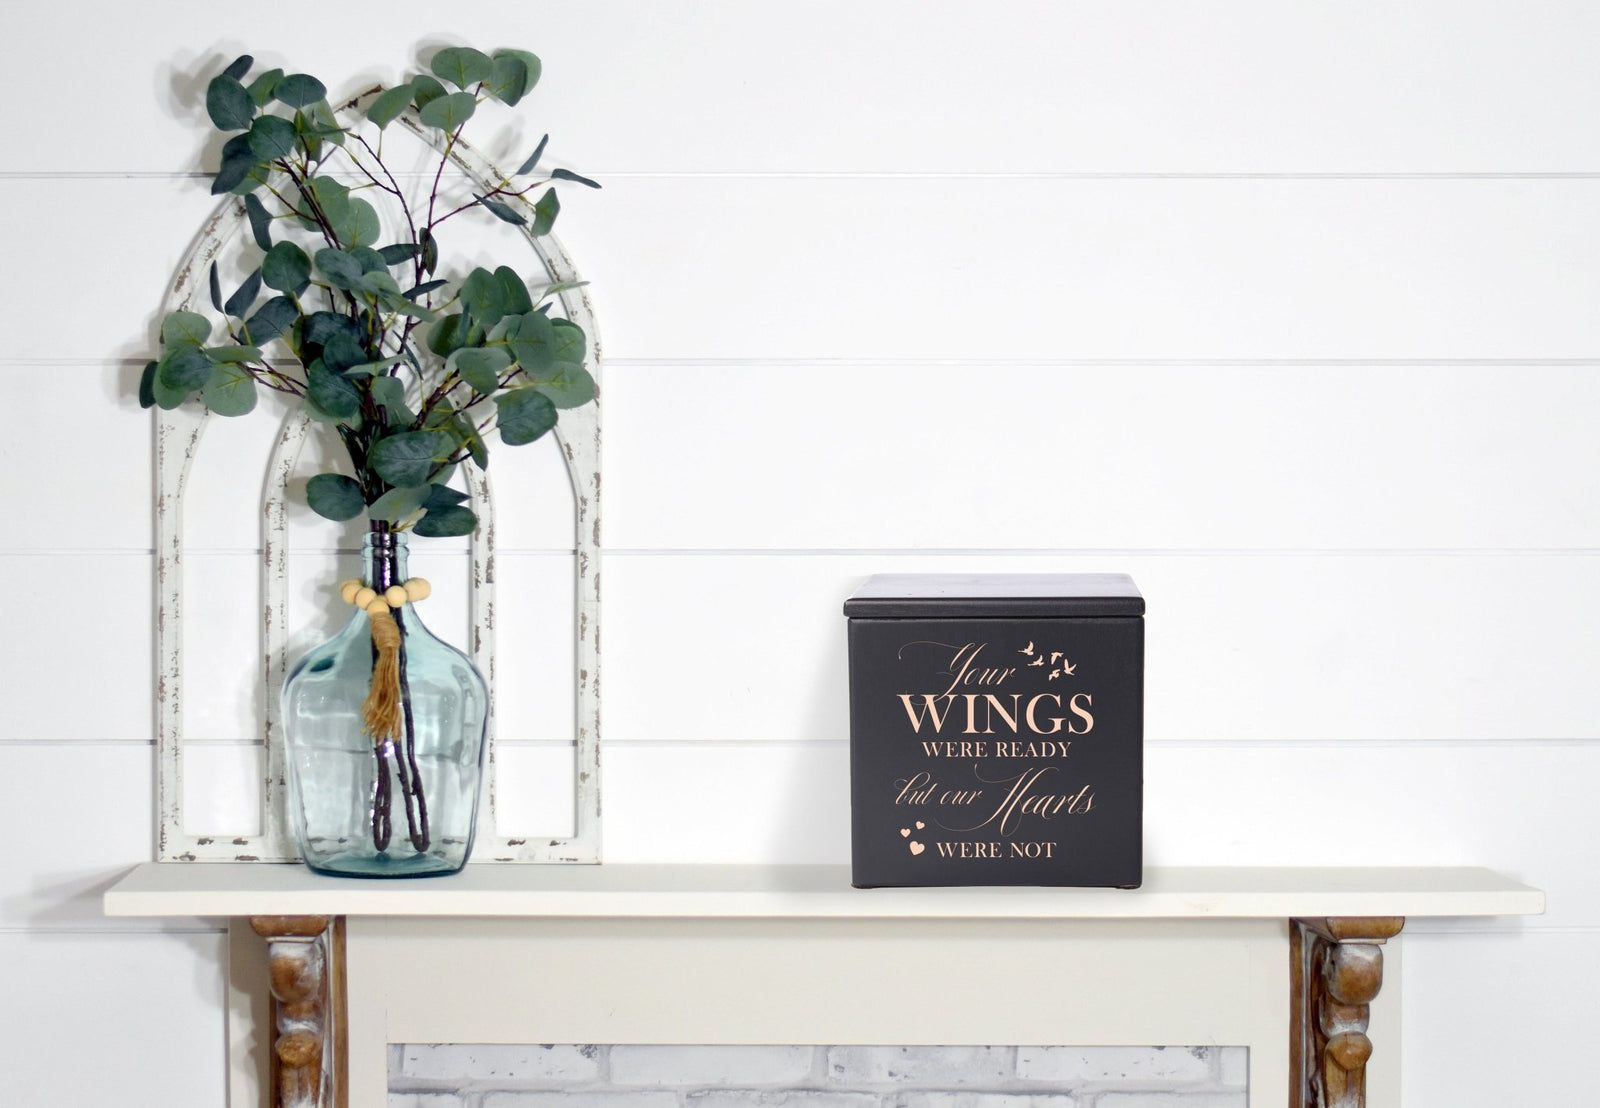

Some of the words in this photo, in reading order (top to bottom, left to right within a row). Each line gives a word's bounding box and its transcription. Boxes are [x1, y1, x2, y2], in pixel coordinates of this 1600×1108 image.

[898, 641, 1016, 705] Your
[897, 693, 1095, 734] WINGS
[922, 741, 988, 758] WERE
[996, 741, 1072, 758] READY
[894, 772, 938, 805] but
[934, 764, 1096, 837] Hearts
[940, 789, 983, 805] our
[936, 842, 1002, 858] WERE
[1010, 842, 1057, 858] NOT
